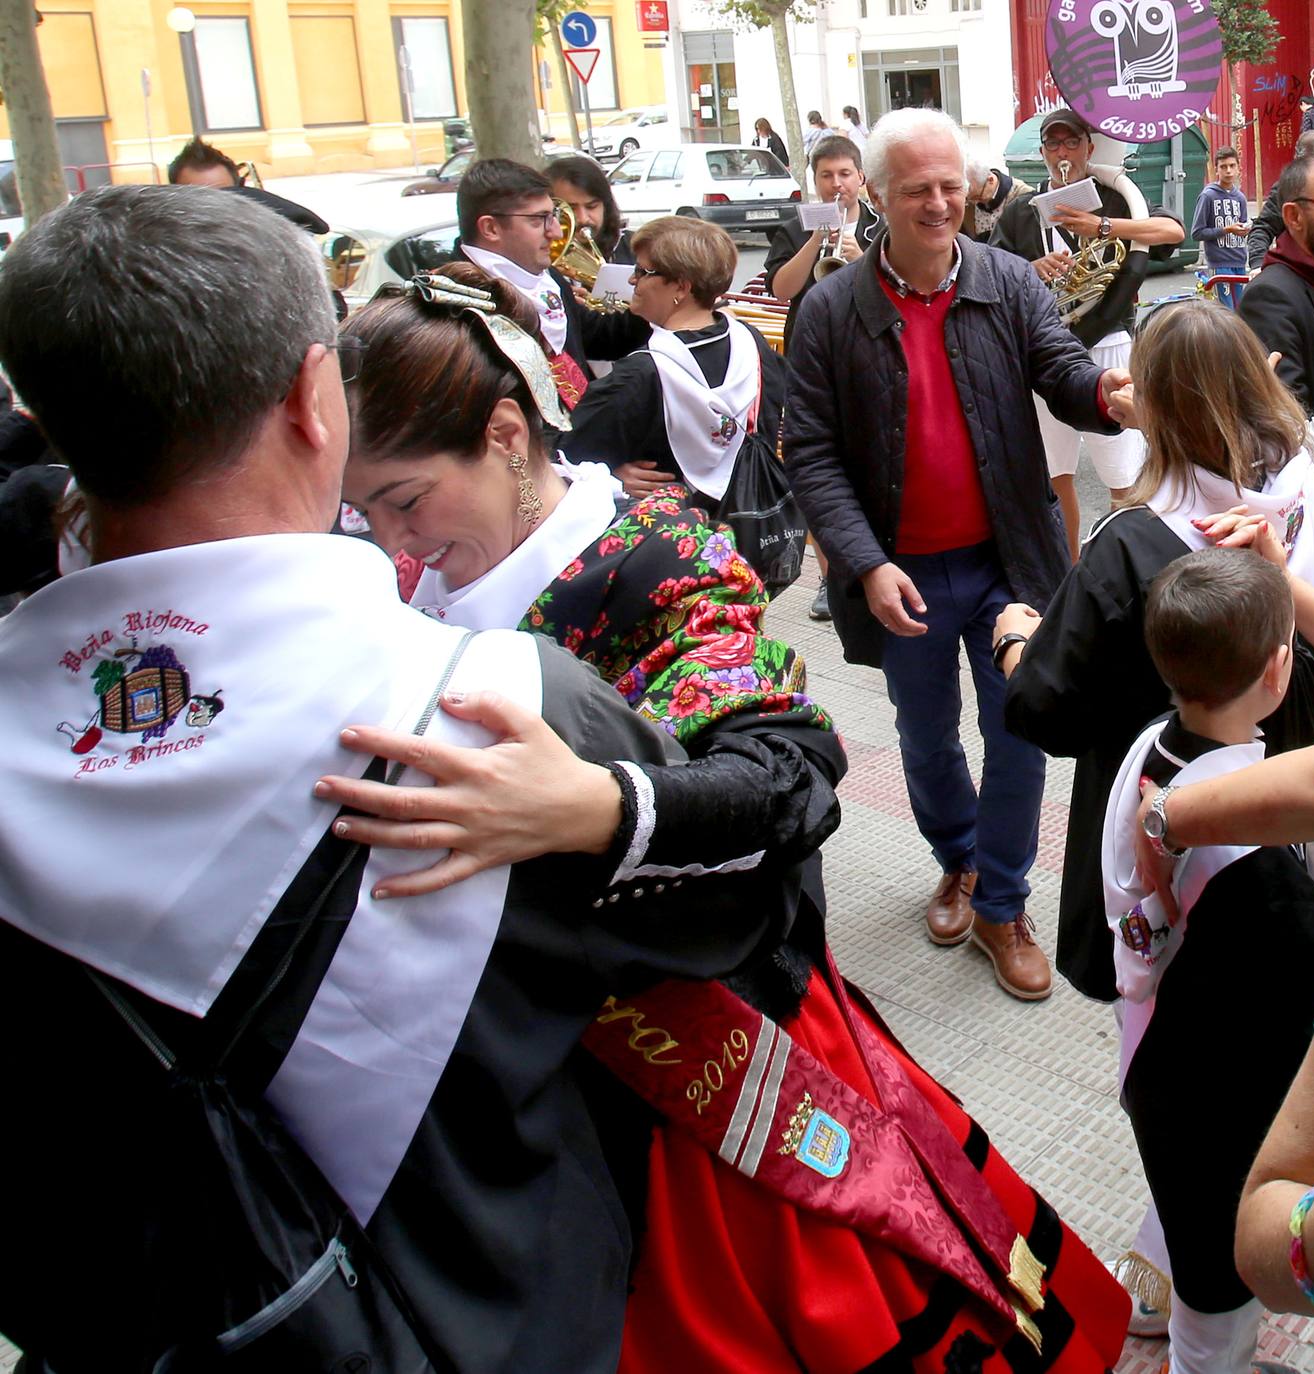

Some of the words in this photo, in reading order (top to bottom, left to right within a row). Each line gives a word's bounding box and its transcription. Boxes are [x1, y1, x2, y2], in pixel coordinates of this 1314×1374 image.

[1100, 116, 1136, 138] 664
[1136, 122, 1157, 139] 39
[1158, 118, 1182, 137] 76
[1176, 108, 1201, 128] 29
[59, 628, 114, 673] Peña
[122, 609, 210, 637] Riojana
[74, 755, 119, 779] Los
[124, 734, 205, 769] Brincos
[686, 1029, 750, 1115] 2019
